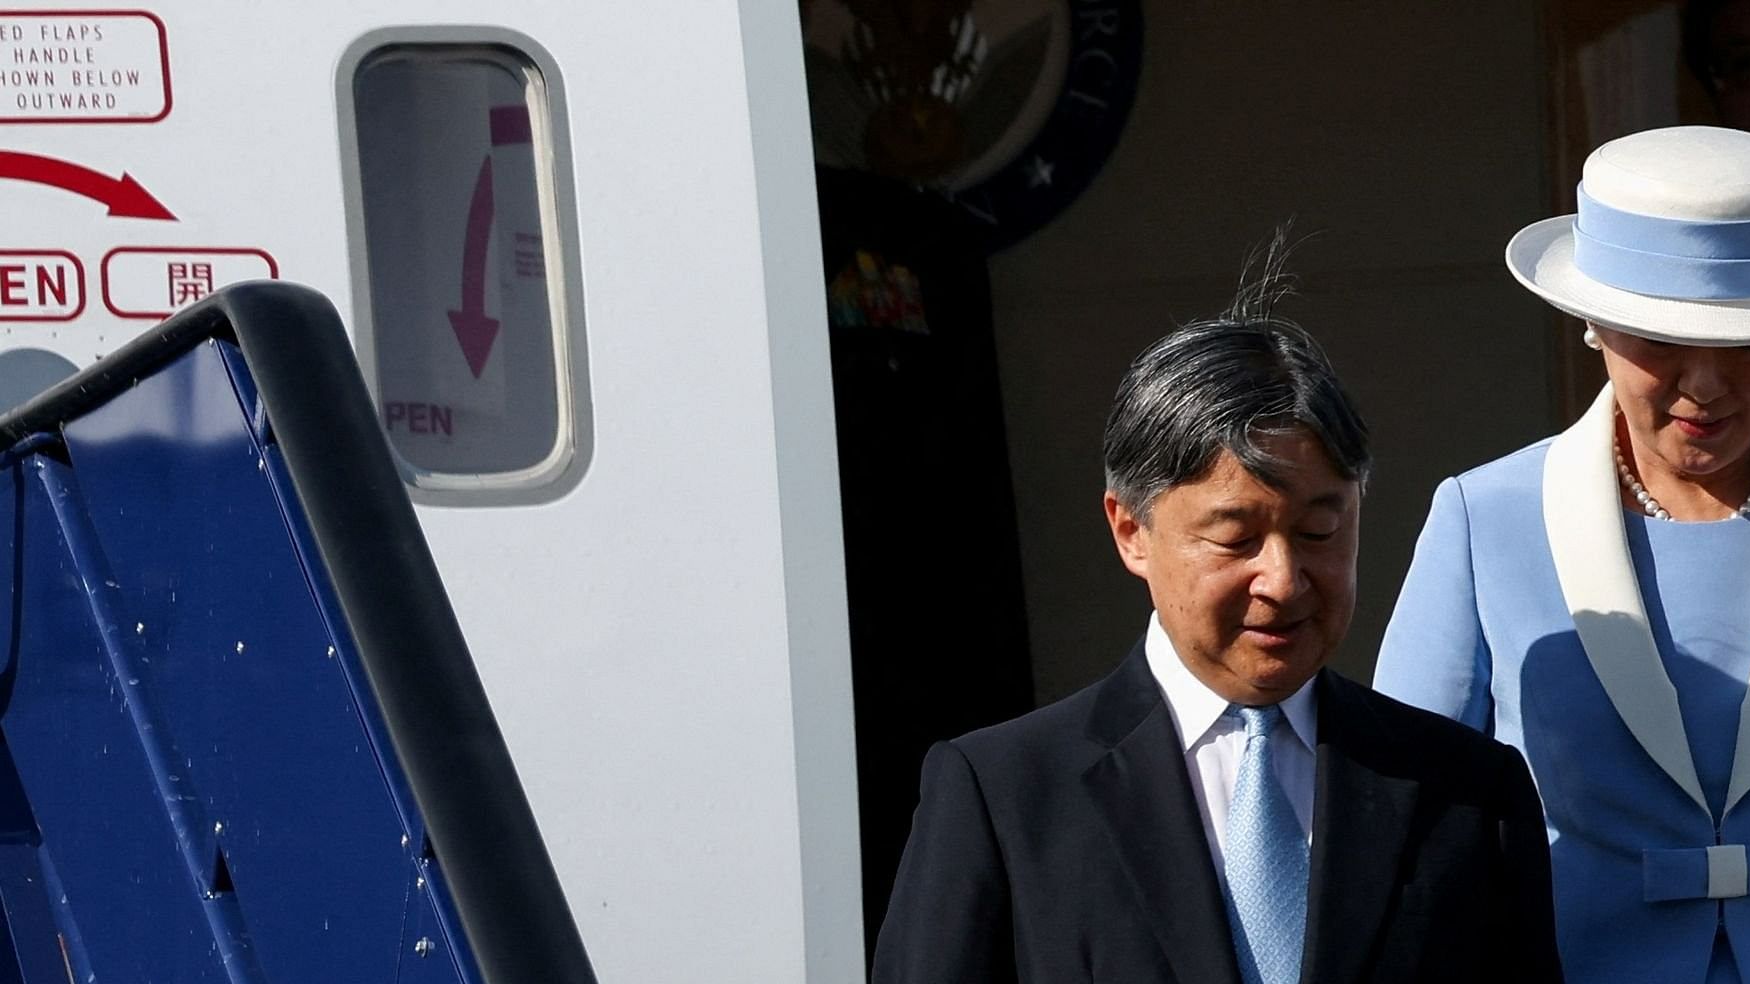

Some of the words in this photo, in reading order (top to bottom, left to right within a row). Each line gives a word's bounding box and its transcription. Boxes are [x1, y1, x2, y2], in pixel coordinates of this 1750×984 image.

[41, 25, 104, 41] FLAPS
[14, 48, 96, 64] HANDLE
[72, 69, 140, 87] BELOW
[17, 93, 117, 110] OUTWARD
[0, 265, 66, 305] EN
[168, 262, 213, 306] 開
[384, 401, 453, 435] PEN
